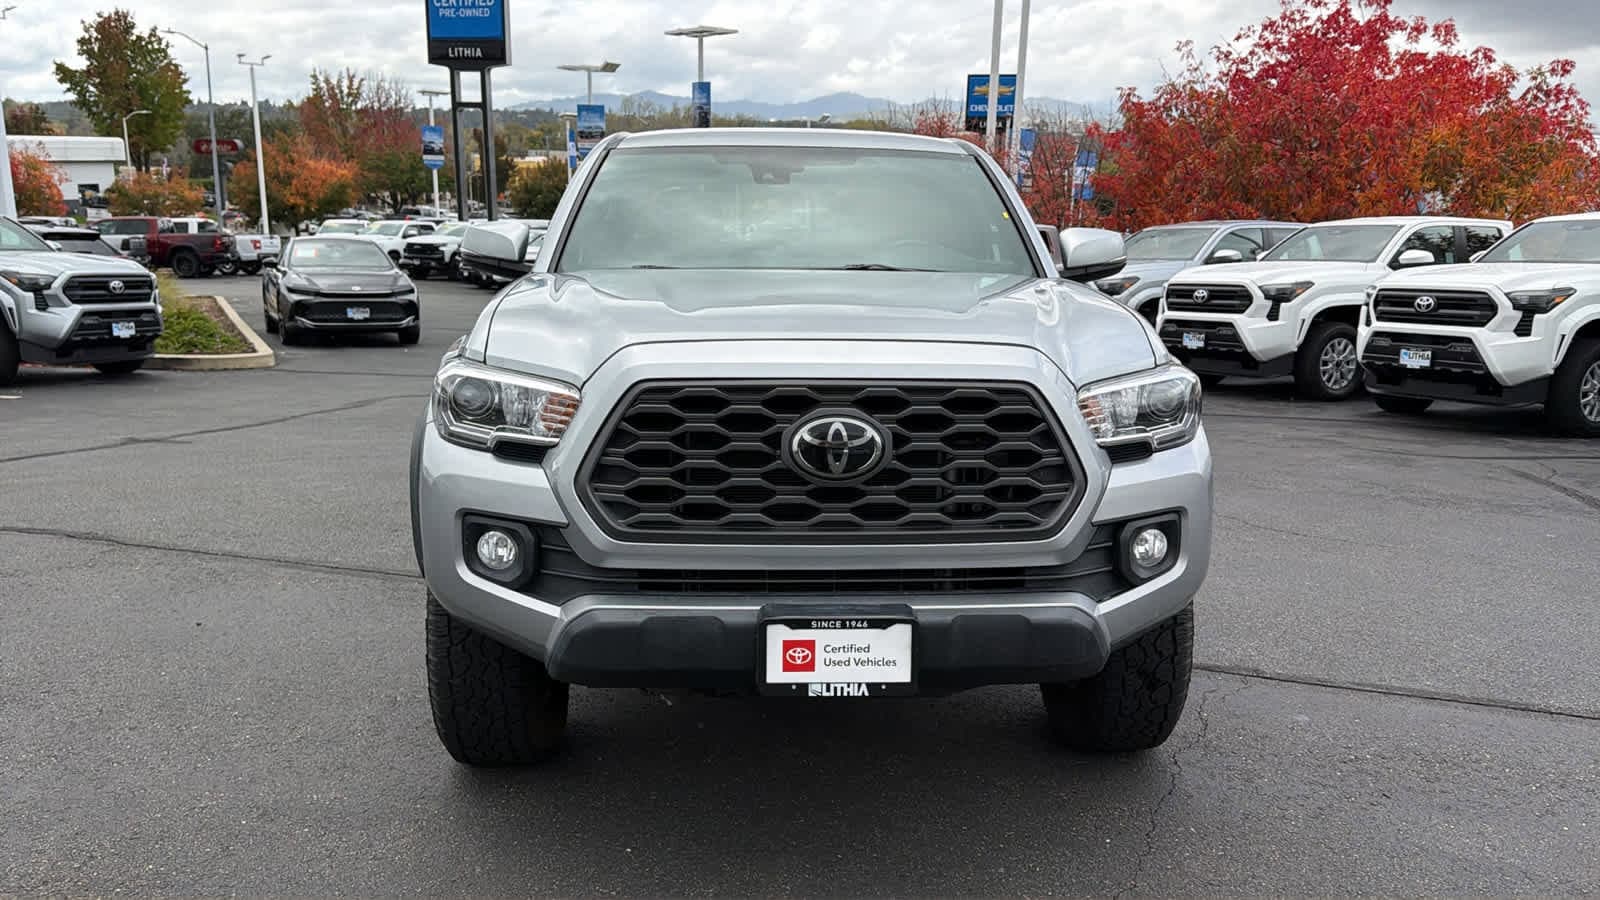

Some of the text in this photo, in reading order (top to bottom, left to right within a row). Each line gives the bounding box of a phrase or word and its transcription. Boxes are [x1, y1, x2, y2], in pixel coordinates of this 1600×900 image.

[439, 8, 490, 17] PRE-OWNED
[448, 47, 483, 58] LITHIA
[1408, 352, 1430, 360] LITHIA
[811, 620, 869, 629] SINCE 1946
[823, 644, 871, 654] Certified
[823, 657, 897, 667] Used Vehicles
[822, 683, 869, 697] LITHIA
